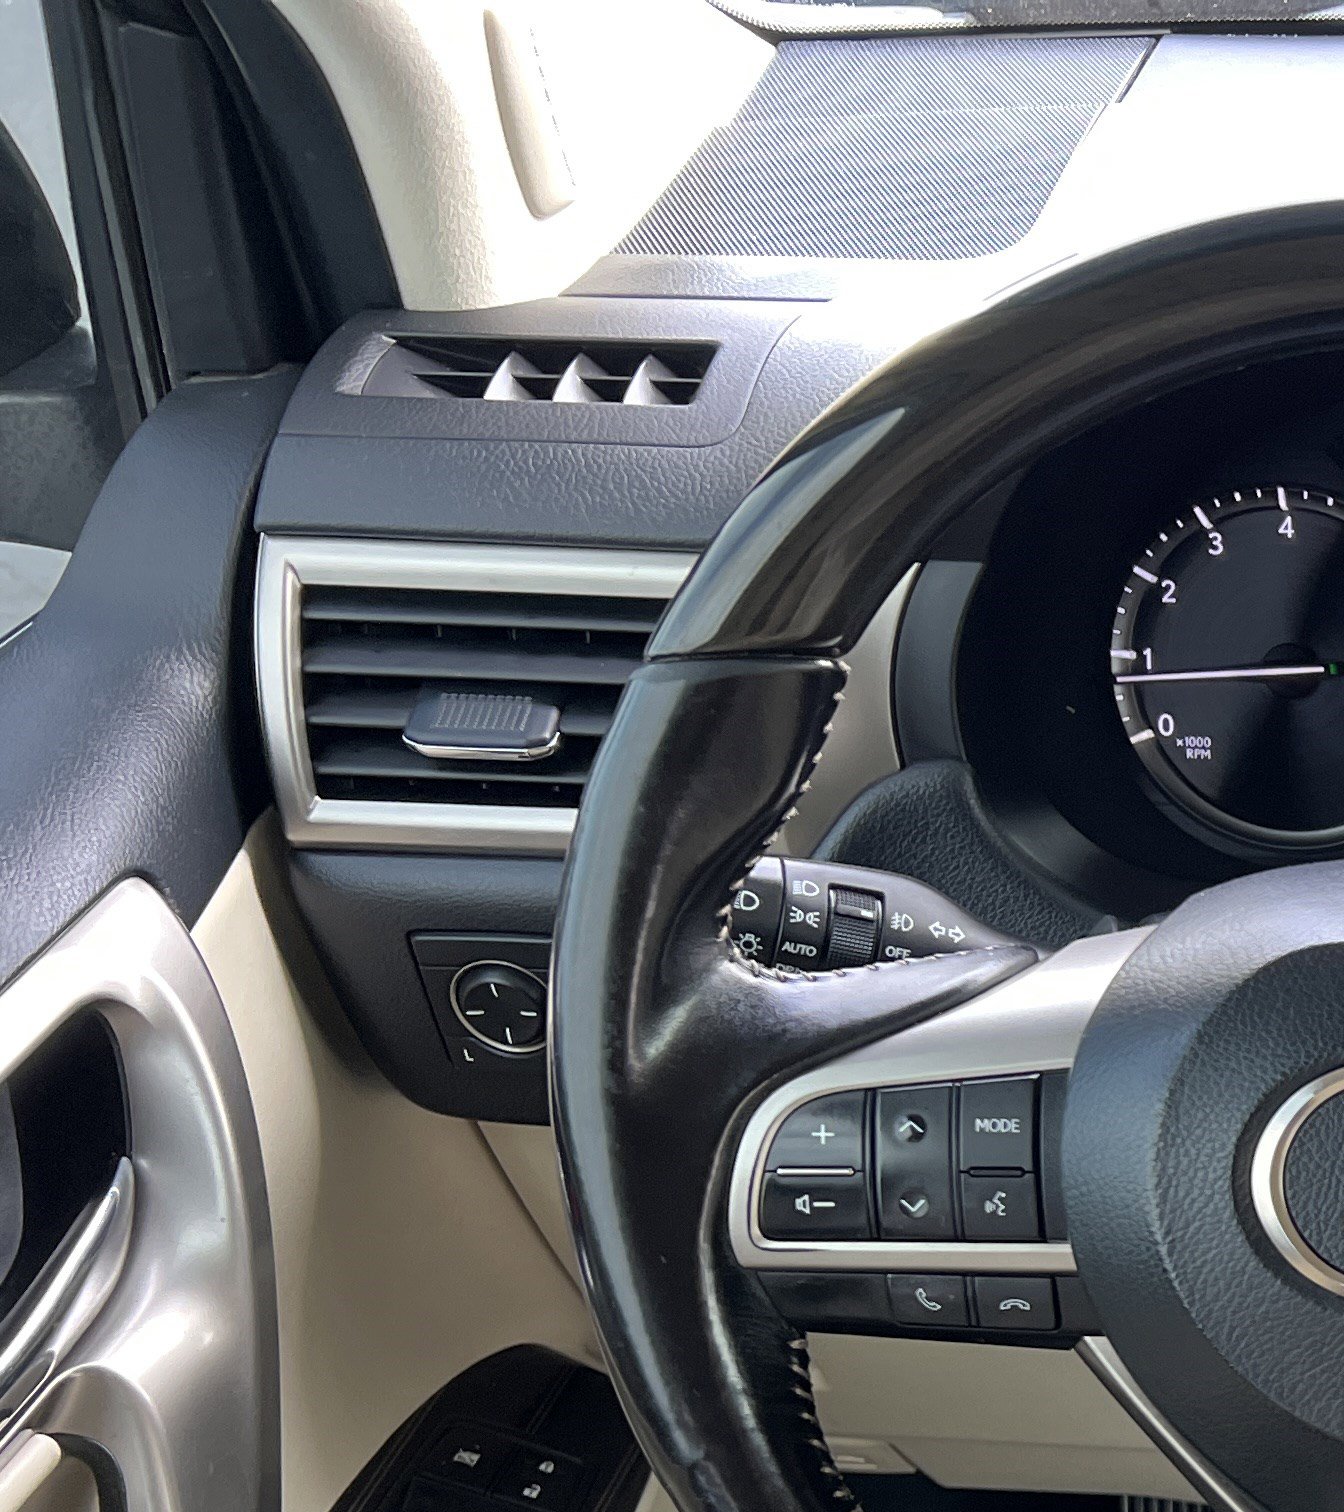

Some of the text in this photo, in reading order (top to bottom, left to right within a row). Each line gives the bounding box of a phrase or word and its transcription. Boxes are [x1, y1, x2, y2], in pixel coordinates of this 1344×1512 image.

[1278, 516, 1295, 539] 4
[1208, 533, 1224, 555] 3
[1161, 580, 1177, 604] 2
[1143, 647, 1153, 669] 1
[1157, 714, 1175, 737] 0
[1186, 748, 1212, 761] RPM
[781, 941, 818, 957] AUTO
[974, 1117, 1021, 1134] MODE
